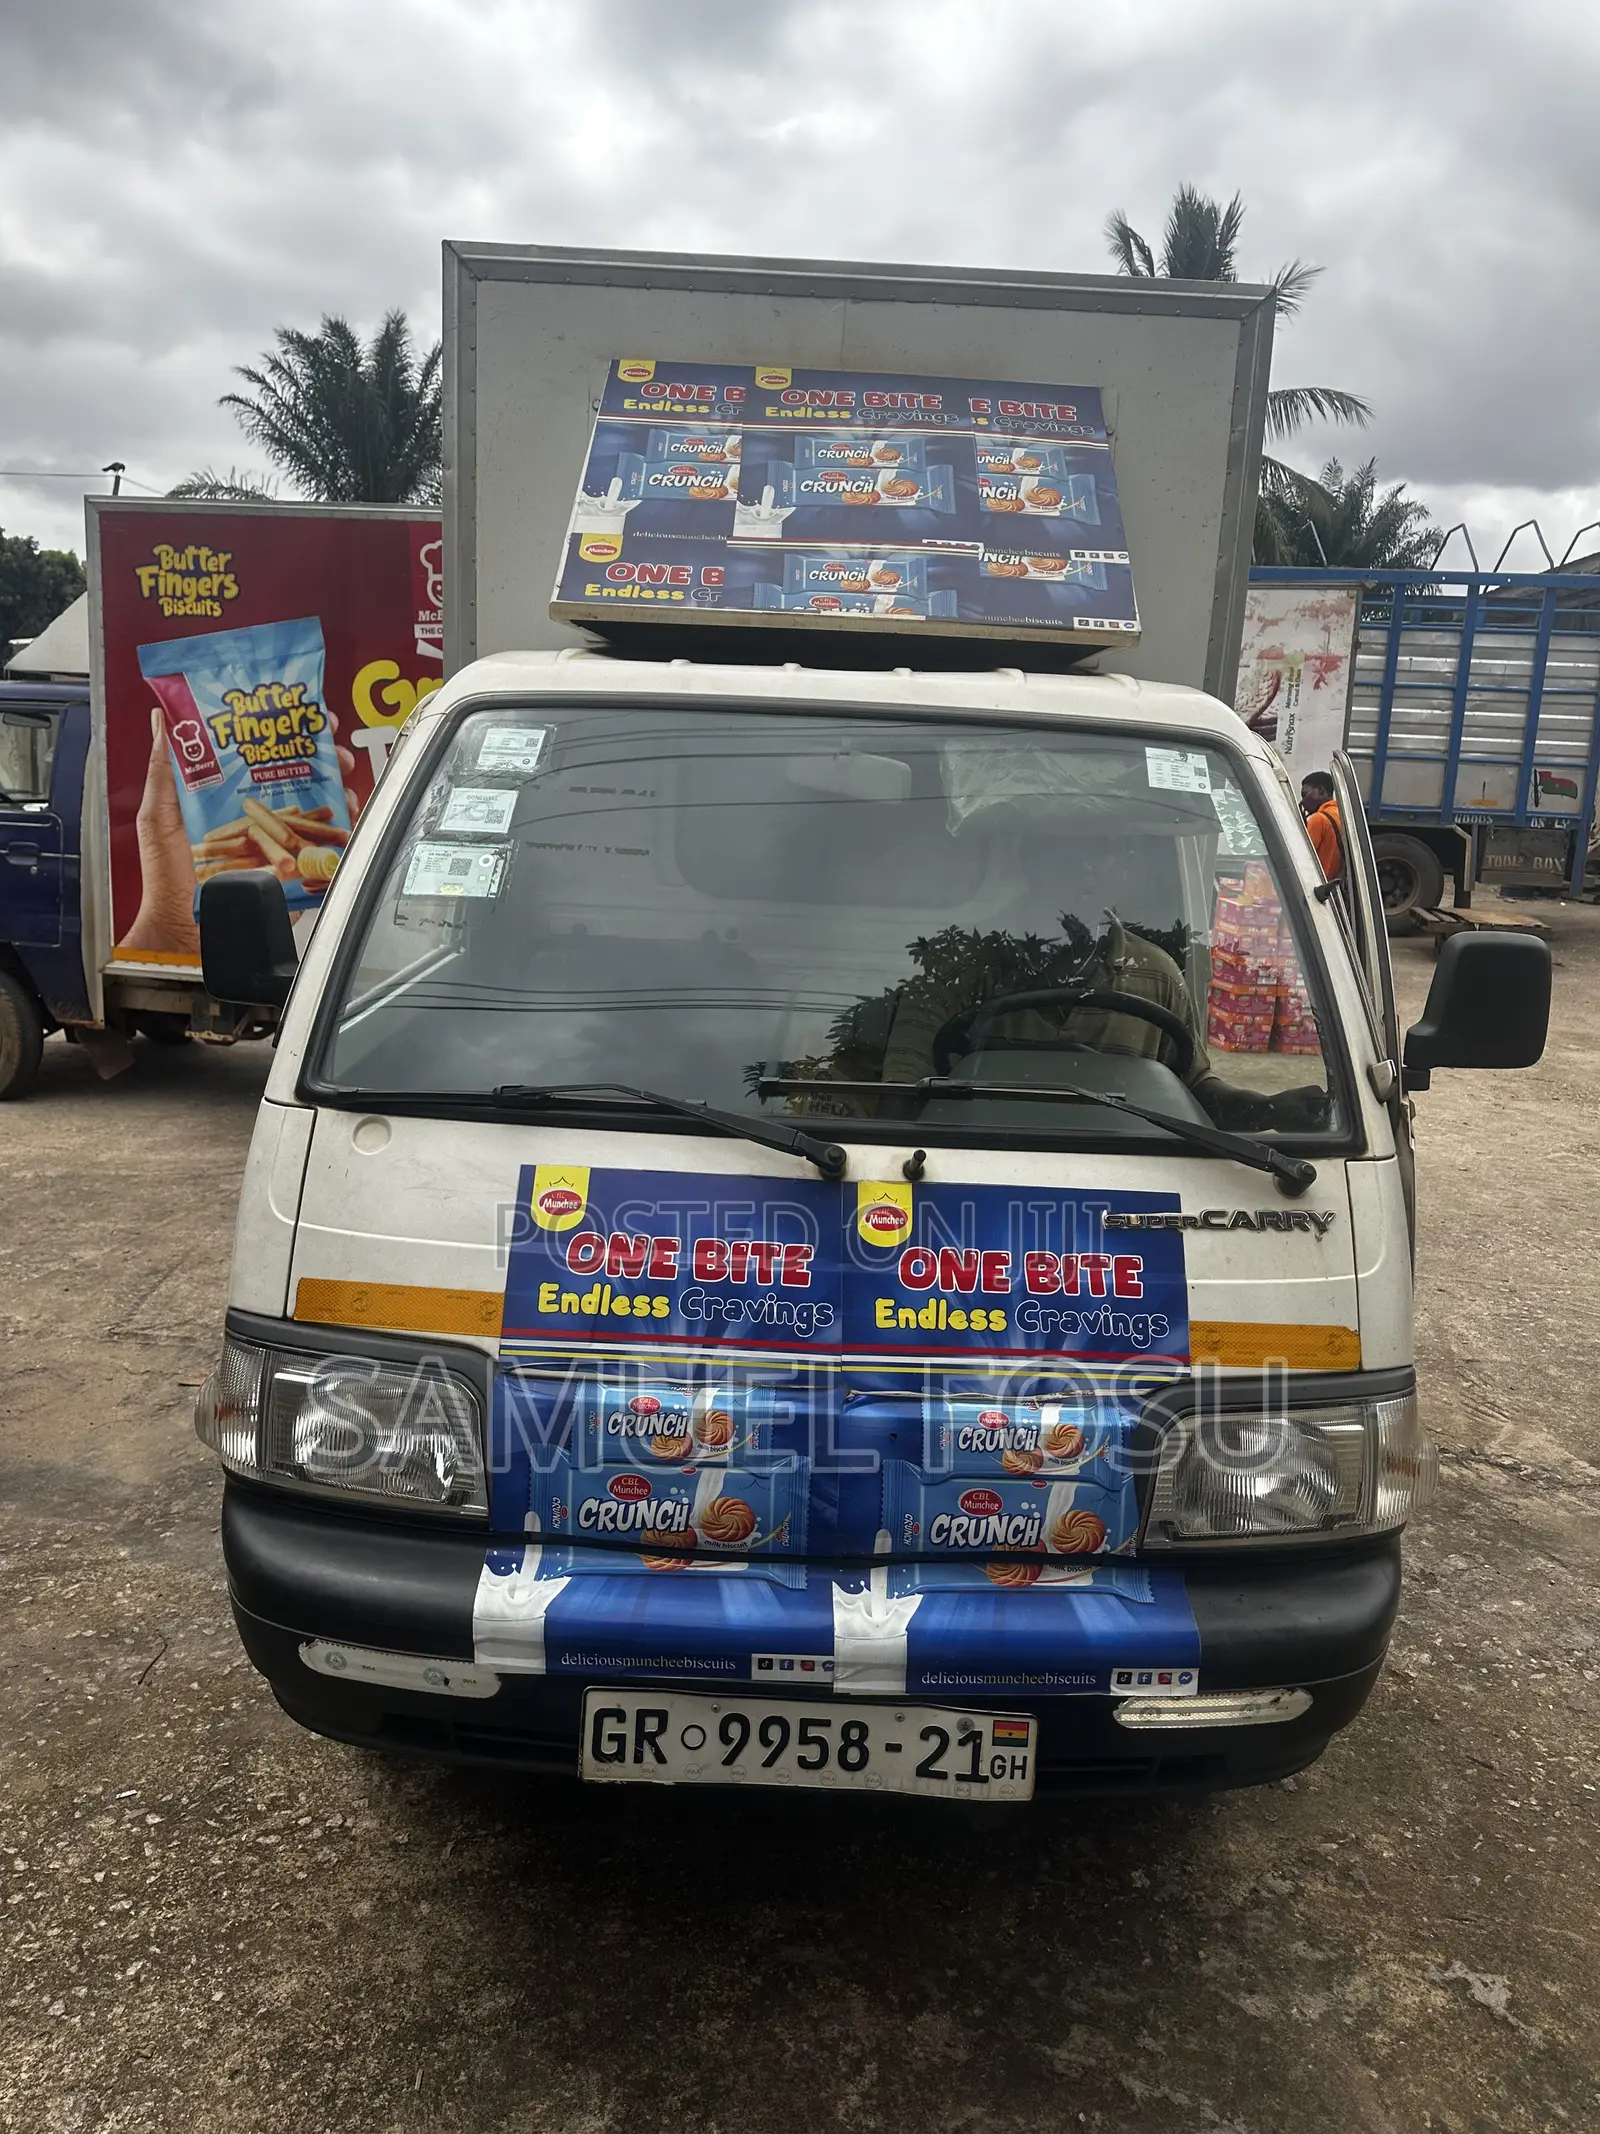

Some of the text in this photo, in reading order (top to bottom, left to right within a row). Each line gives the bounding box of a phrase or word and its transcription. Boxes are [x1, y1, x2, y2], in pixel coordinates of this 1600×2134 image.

[641, 383, 717, 401] ONE
[780, 389, 943, 410] ONE BITE
[623, 398, 710, 413] Endless
[765, 406, 959, 425] Endless Cravings
[998, 400, 1077, 421] BITE
[993, 416, 1096, 436] Cravings
[670, 443, 724, 453] CRUNCH
[817, 449, 870, 459] CRUNCH
[648, 474, 724, 488] CRUNCH
[800, 480, 875, 493] CRUNCH
[153, 544, 232, 572] Butter
[606, 563, 693, 585] ONE
[809, 570, 866, 581] CRUNCH
[135, 565, 239, 604] Fingers
[585, 583, 685, 600] Endless
[158, 596, 222, 617] Biscuits
[420, 627, 436, 636] THE
[224, 684, 305, 716] Butter
[209, 704, 325, 748] Fingers
[239, 736, 316, 765] Biscuits
[253, 764, 312, 782] PURE BUTTER
[1533, 856, 1566, 873] BOX
[544, 1198, 579, 1210] Munchee
[870, 1214, 905, 1225] Munchee
[566, 1231, 815, 1288] ONE BITE
[898, 1246, 1144, 1299] ONE BITE
[537, 1282, 835, 1338] Endless Cravings
[874, 1297, 1170, 1349] Endless Cravings
[607, 1411, 689, 1438] CRUNCH
[958, 1425, 1039, 1452] CRUNCH
[612, 1486, 648, 1496] Munchee
[621, 1477, 640, 1486] CBL
[963, 1500, 1000, 1510] Munchee
[972, 1492, 990, 1501] CBL
[552, 1497, 561, 1530] CRUNCH
[578, 1497, 691, 1533] CRUNCH
[904, 1514, 914, 1546] CRUNCH
[931, 1513, 1041, 1548] CRUNCH
[704, 1539, 748, 1549] milk biscuit
[561, 1652, 737, 1671] deliciousmuncheebiscuits
[921, 1671, 1097, 1688] deliciousmuncheebiscuits
[592, 1708, 669, 1765] GR
[990, 1755, 1028, 1780] GH
